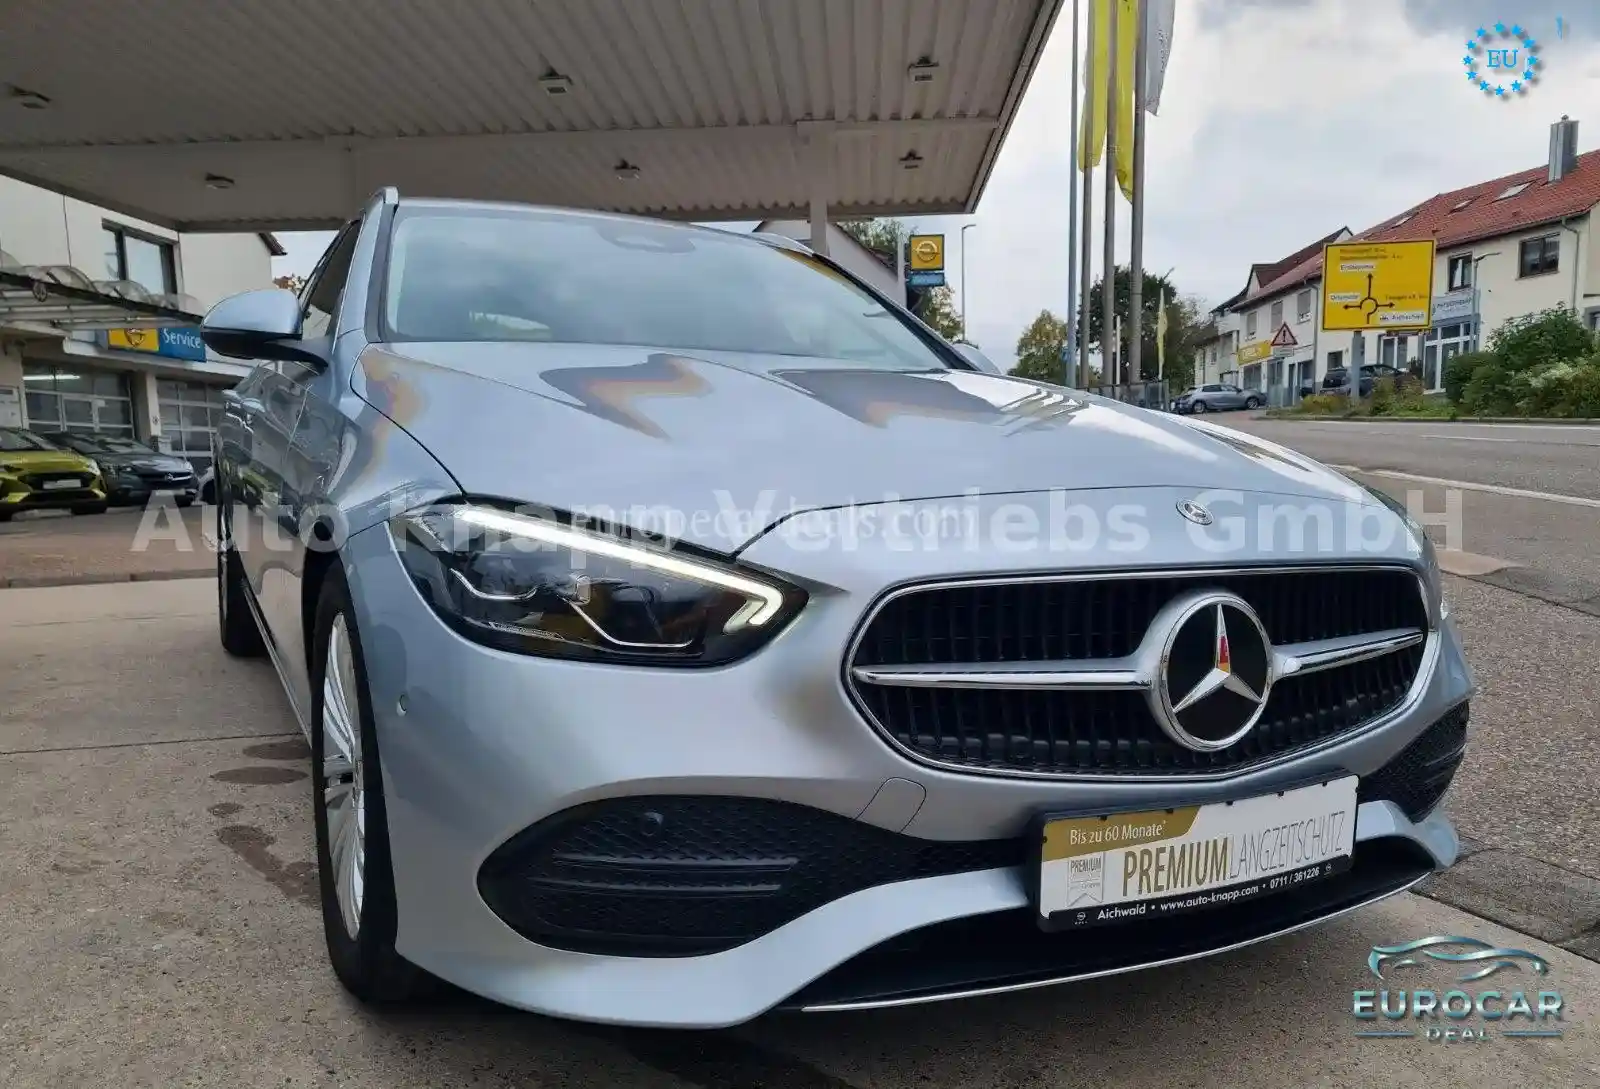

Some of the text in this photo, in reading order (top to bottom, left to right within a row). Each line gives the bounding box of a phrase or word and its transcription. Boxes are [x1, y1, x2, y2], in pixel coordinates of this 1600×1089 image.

[164, 327, 200, 349] Service
[1070, 829, 1087, 846] Bis
[1088, 830, 1103, 844] zu
[1104, 826, 1119, 842] 60
[1070, 857, 1101, 873] PREMIUM
[1097, 902, 1146, 920] Aichwald
[1160, 885, 1259, 911] www.auto-knapp.com
